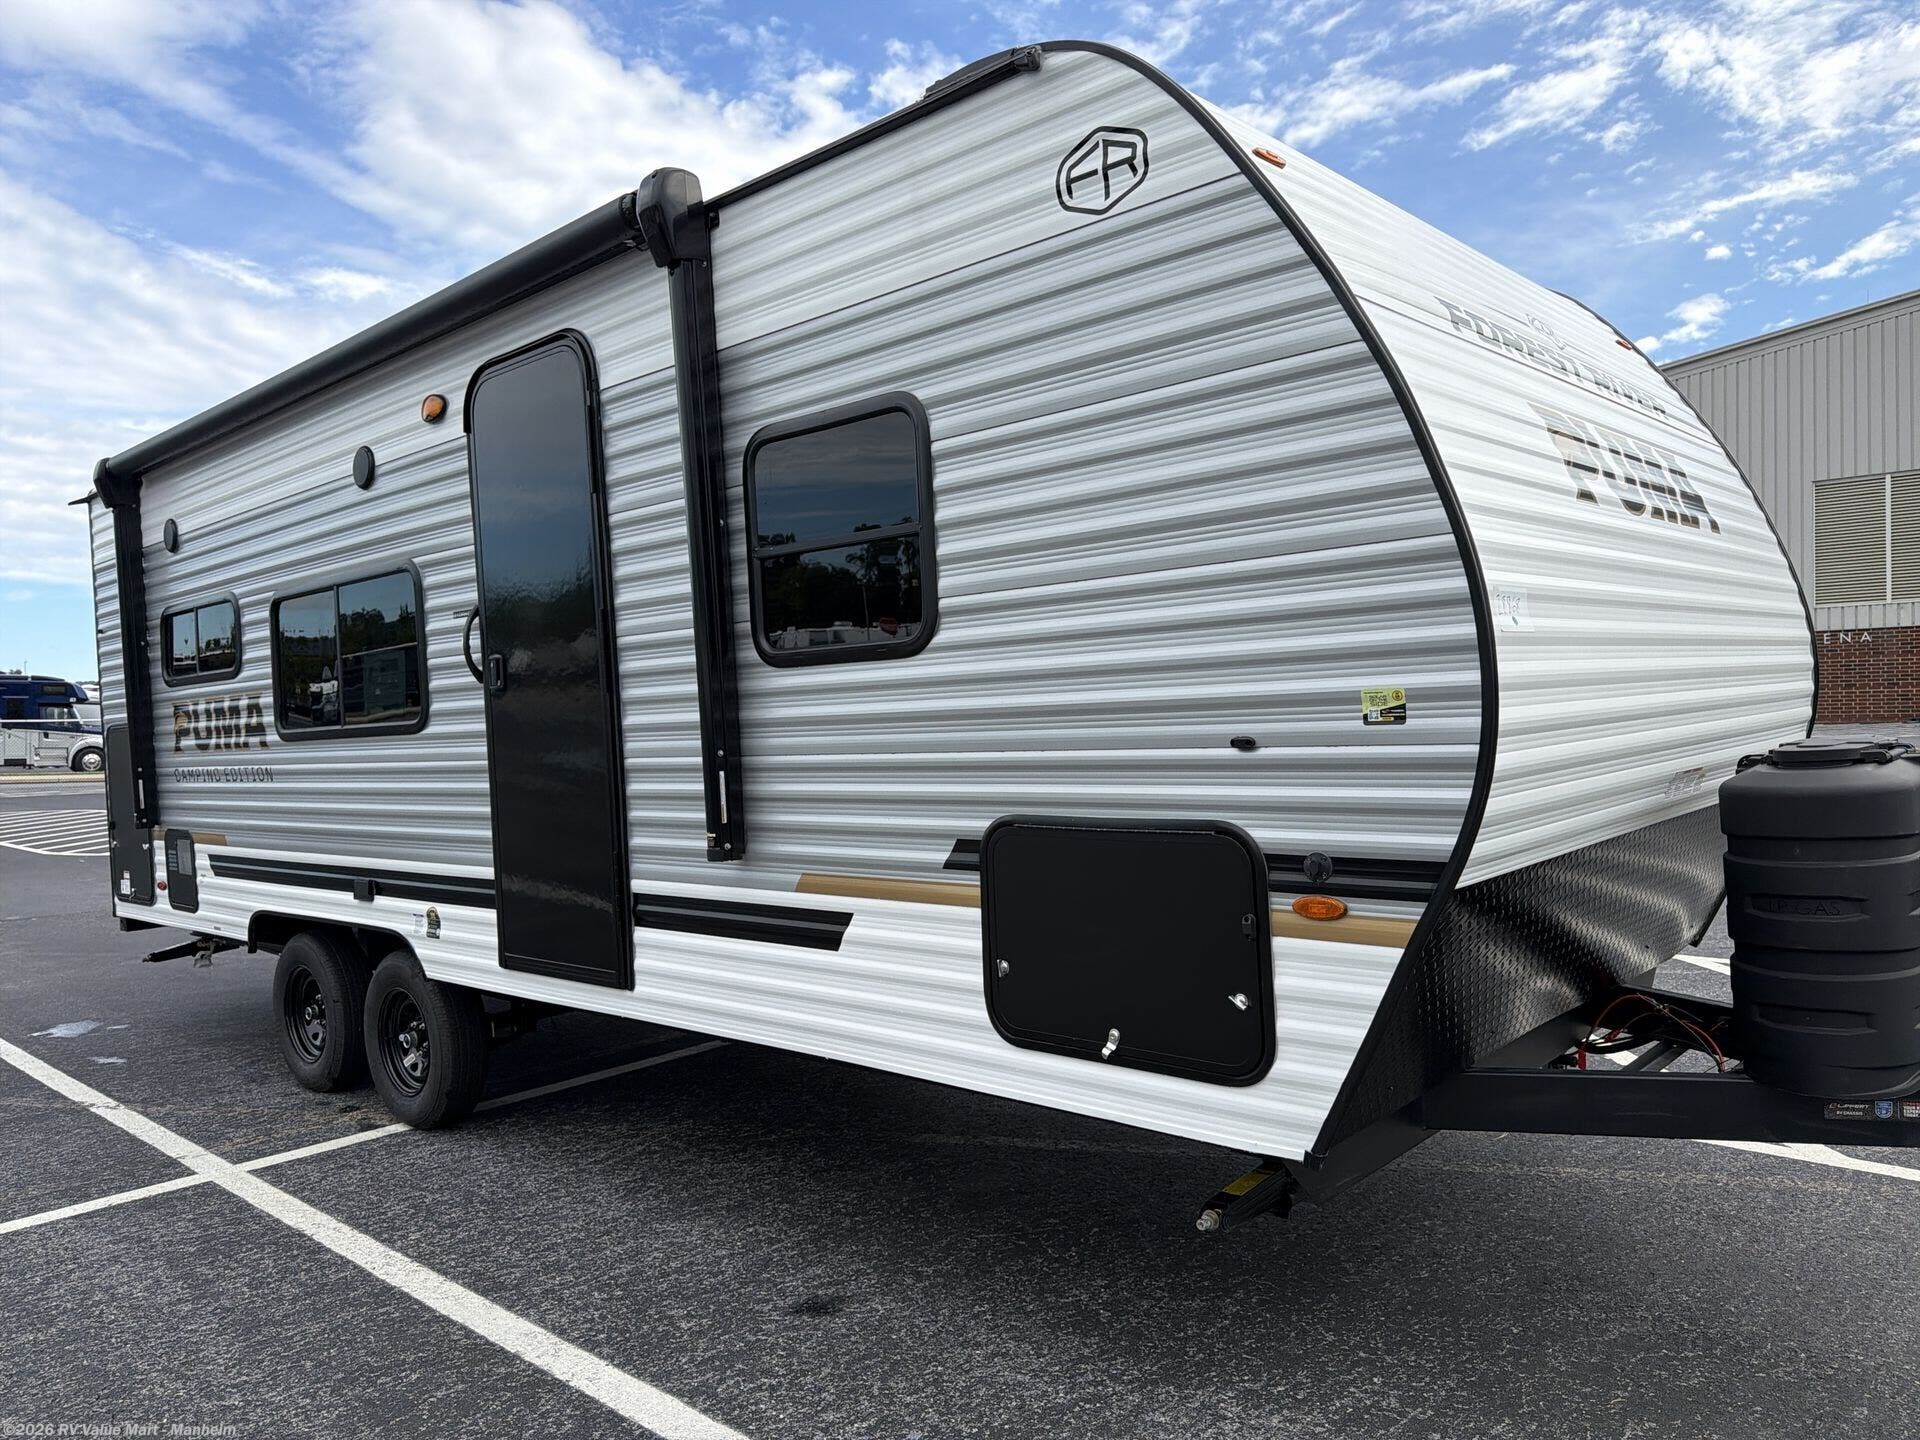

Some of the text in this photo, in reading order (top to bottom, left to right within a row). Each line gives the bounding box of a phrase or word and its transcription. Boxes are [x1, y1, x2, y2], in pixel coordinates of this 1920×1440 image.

[1527, 401, 1721, 535] PUMA
[172, 693, 270, 753] PUMA
[174, 766, 274, 783] CAMPING EDITION
